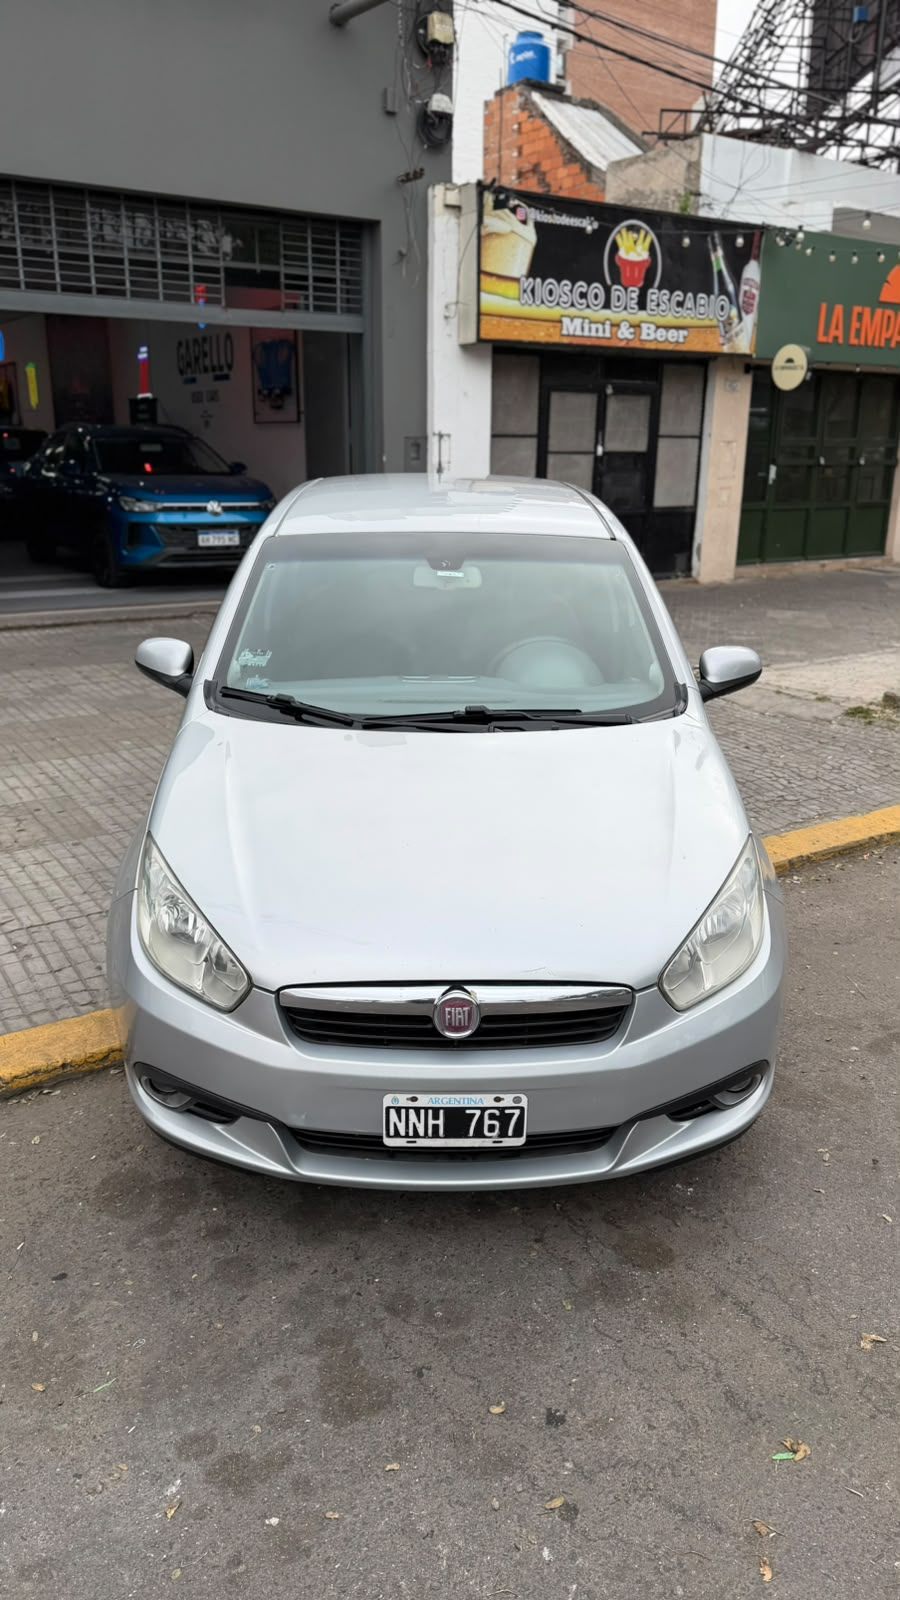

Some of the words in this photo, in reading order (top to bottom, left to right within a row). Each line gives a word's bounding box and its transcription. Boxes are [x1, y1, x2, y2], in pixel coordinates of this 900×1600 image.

[520, 277, 605, 309] KIOSCO
[611, 284, 639, 313] DE
[646, 287, 731, 320] ESCABIO
[561, 316, 611, 338] Mini
[617, 321, 635, 340] &
[640, 322, 688, 344] Beer
[817, 302, 844, 344] LA
[177, 332, 234, 377] GARELLO
[445, 1007, 470, 1026] FIAT
[427, 1096, 485, 1105] ARGENTINA
[389, 1108, 445, 1137] NNH
[465, 1109, 521, 1137] 767
